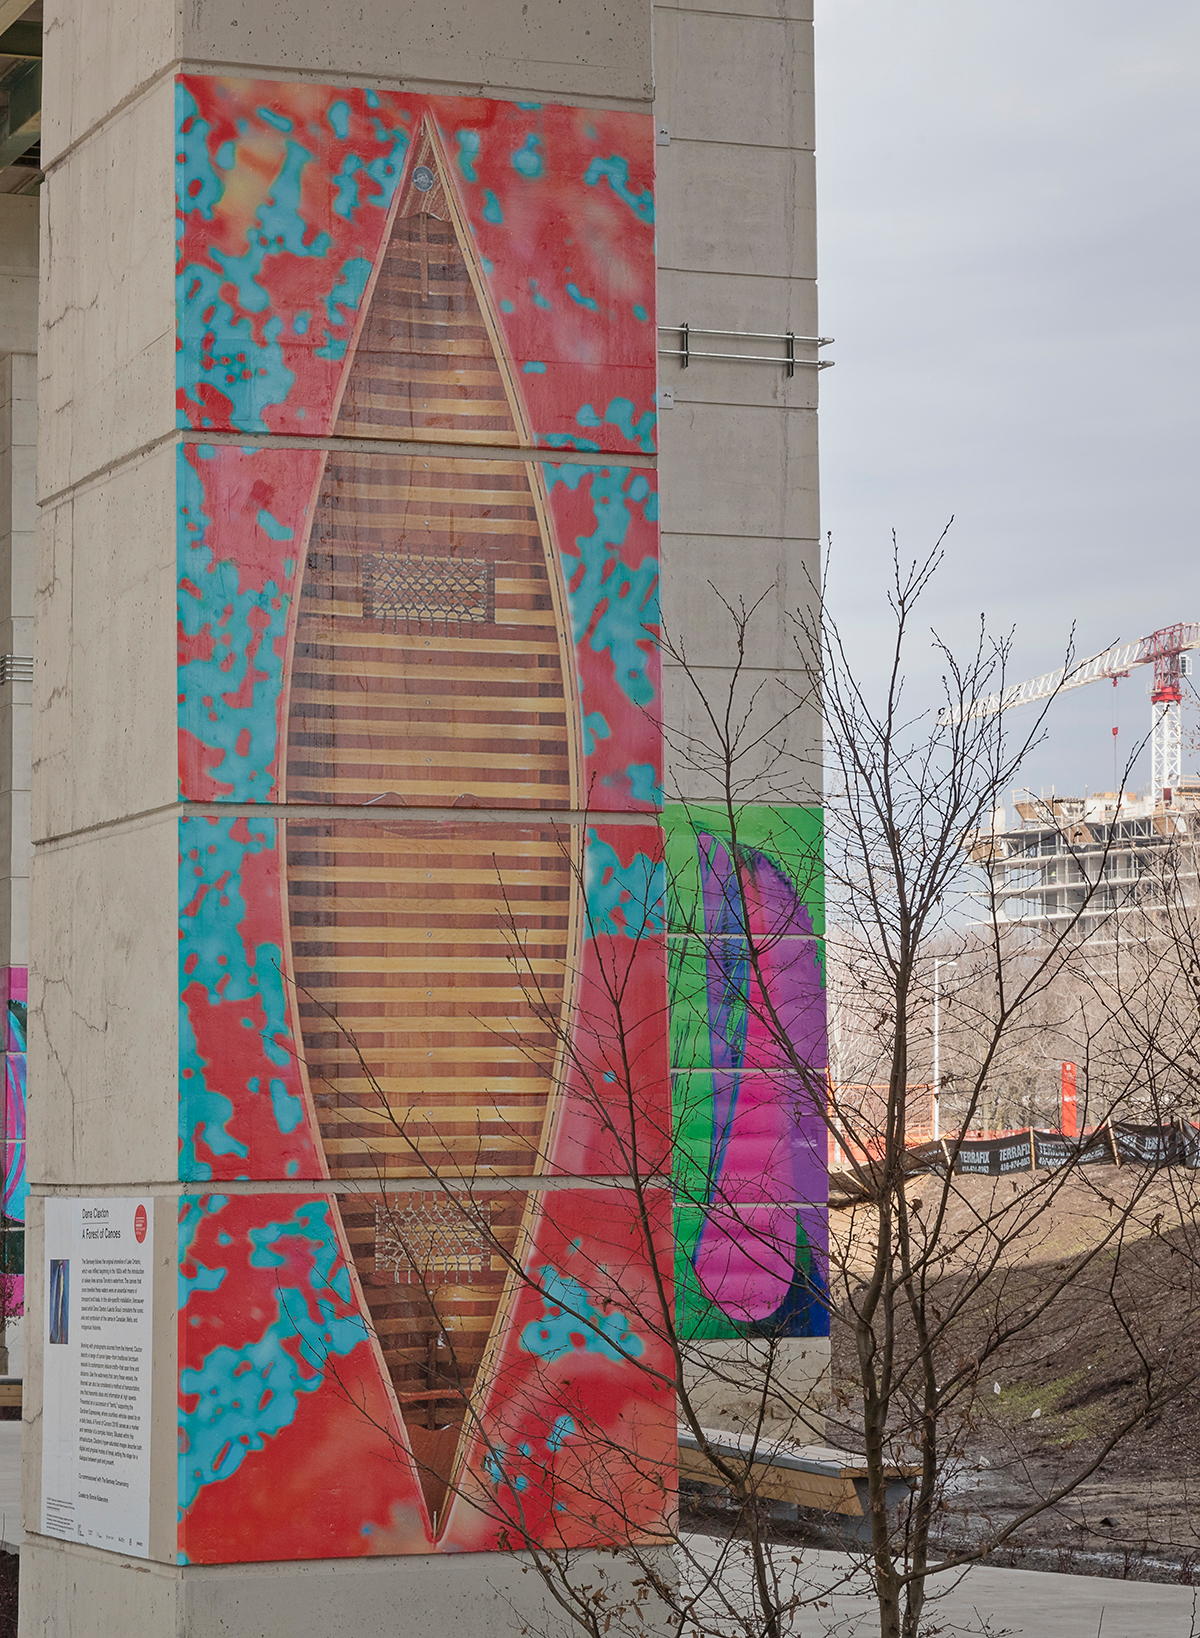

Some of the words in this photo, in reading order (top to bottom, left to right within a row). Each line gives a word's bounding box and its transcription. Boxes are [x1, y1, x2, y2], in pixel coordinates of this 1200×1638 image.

[959, 1150, 990, 1163] TERRAFIX
[82, 1208, 93, 1219] Dana
[86, 1228, 99, 1239] Forest
[99, 1228, 104, 1239] of
[105, 1228, 121, 1239] Canoes
